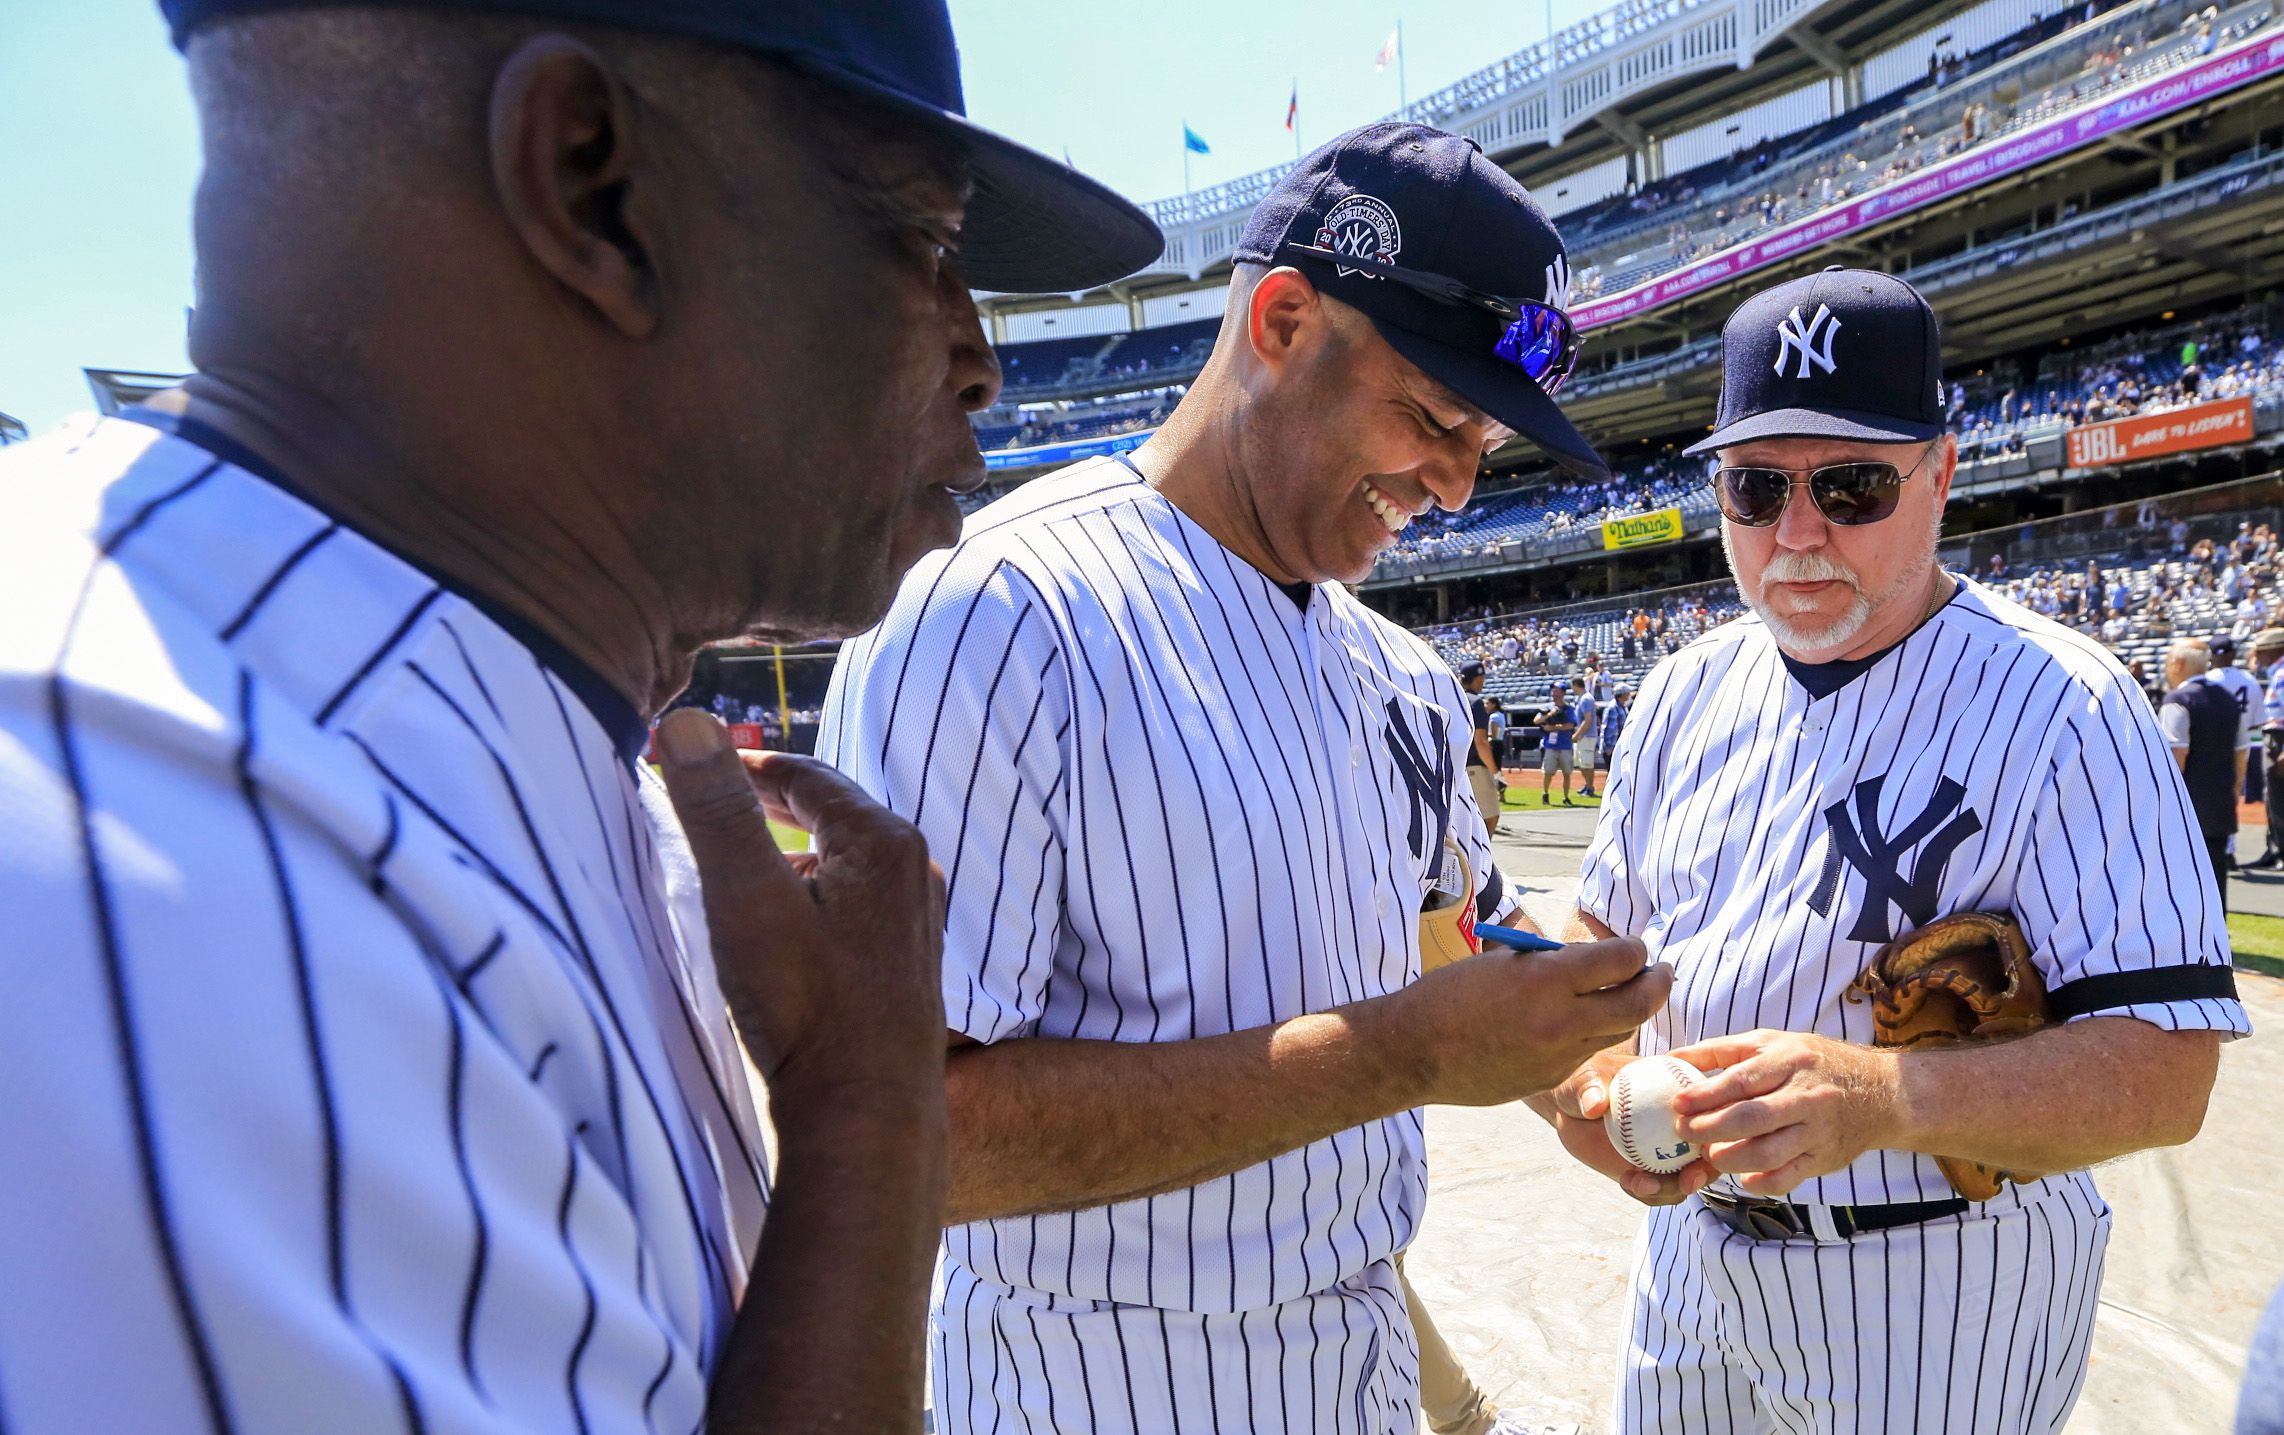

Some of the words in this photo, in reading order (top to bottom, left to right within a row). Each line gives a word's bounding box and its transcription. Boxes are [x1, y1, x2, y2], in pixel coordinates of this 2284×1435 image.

[1947, 161, 1987, 184] TRAVEL
[1994, 128, 2065, 166] DISCOUNTS
[1364, 200, 1395, 233] ANNUAL
[1319, 232, 1332, 243] 20
[1380, 230, 1391, 251] DAY
[1774, 303, 1842, 379] NY
[2074, 426, 2127, 465] JBL
[2170, 423, 2186, 437] TO
[1609, 513, 1671, 538] Nathan's
[1806, 773, 1983, 944] NY
